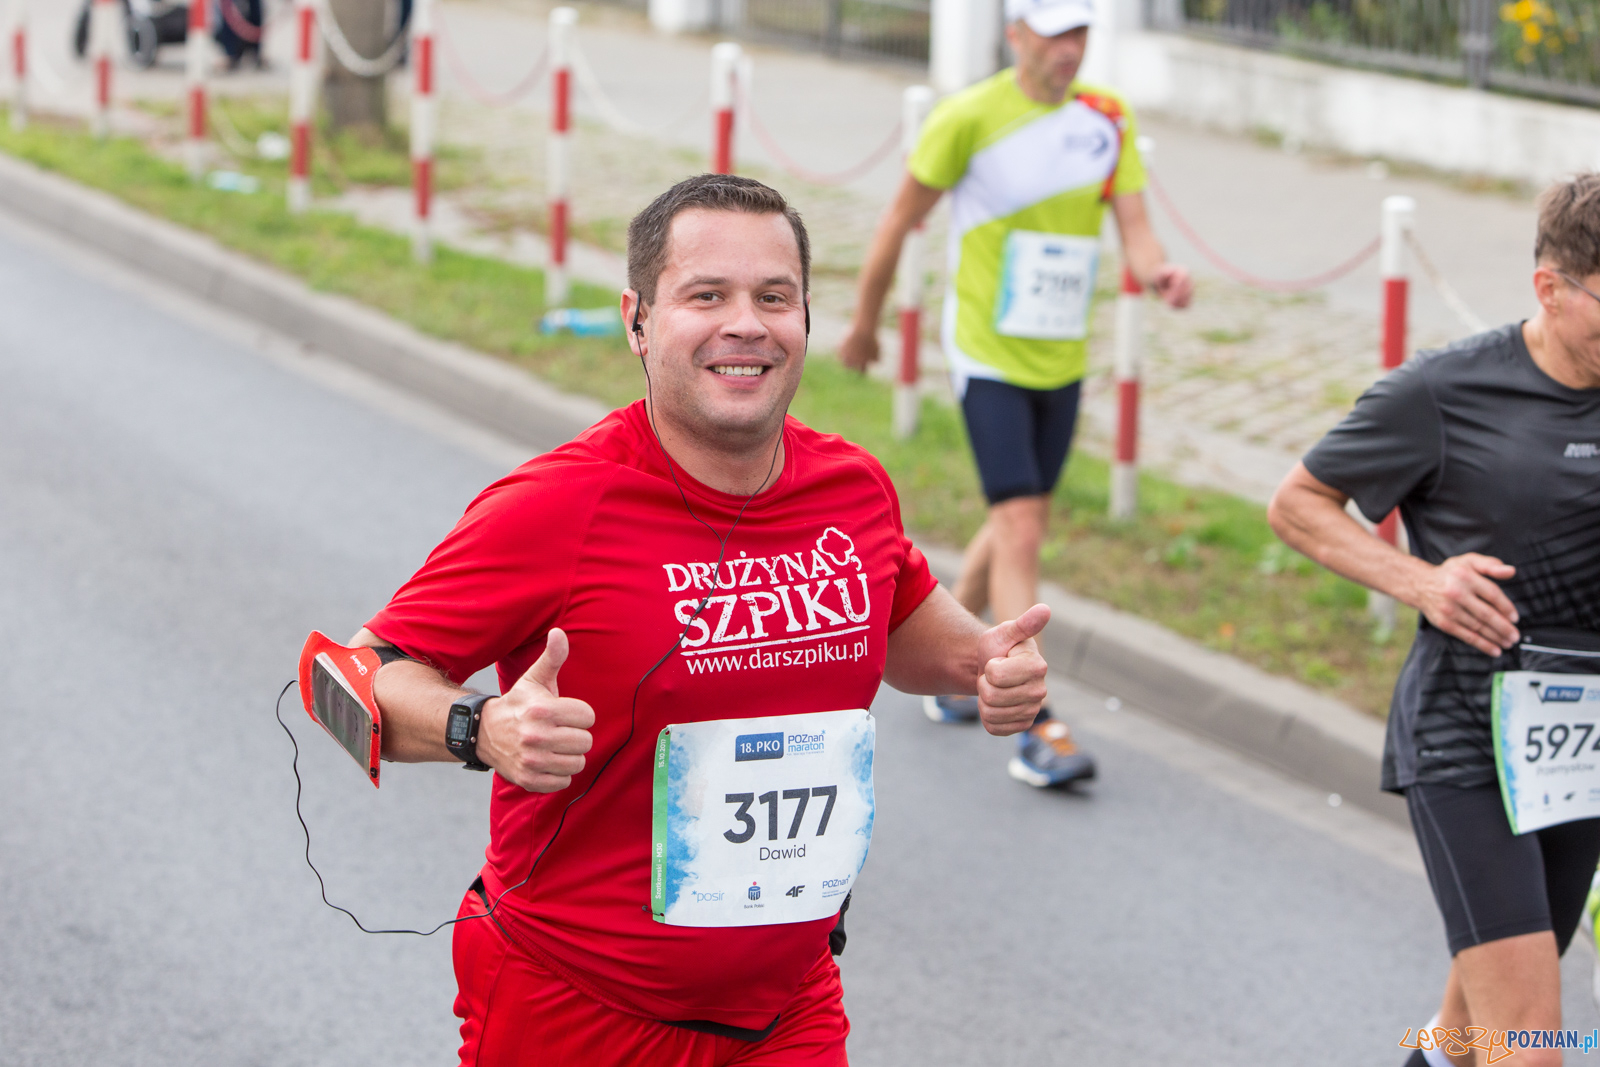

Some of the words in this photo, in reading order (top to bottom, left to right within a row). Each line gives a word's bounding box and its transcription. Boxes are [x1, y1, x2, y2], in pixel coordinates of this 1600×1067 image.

[662, 549, 835, 592] DRUŻYNA
[674, 573, 870, 648] SZPIKU
[686, 636, 868, 675] www.darszpiku.pl
[658, 738, 667, 768] 15.10.2017
[740, 742, 755, 754] 18.
[756, 739, 781, 753] PKO
[788, 742, 825, 752] maraton
[723, 785, 838, 844] 3177
[759, 844, 806, 861] Dawid
